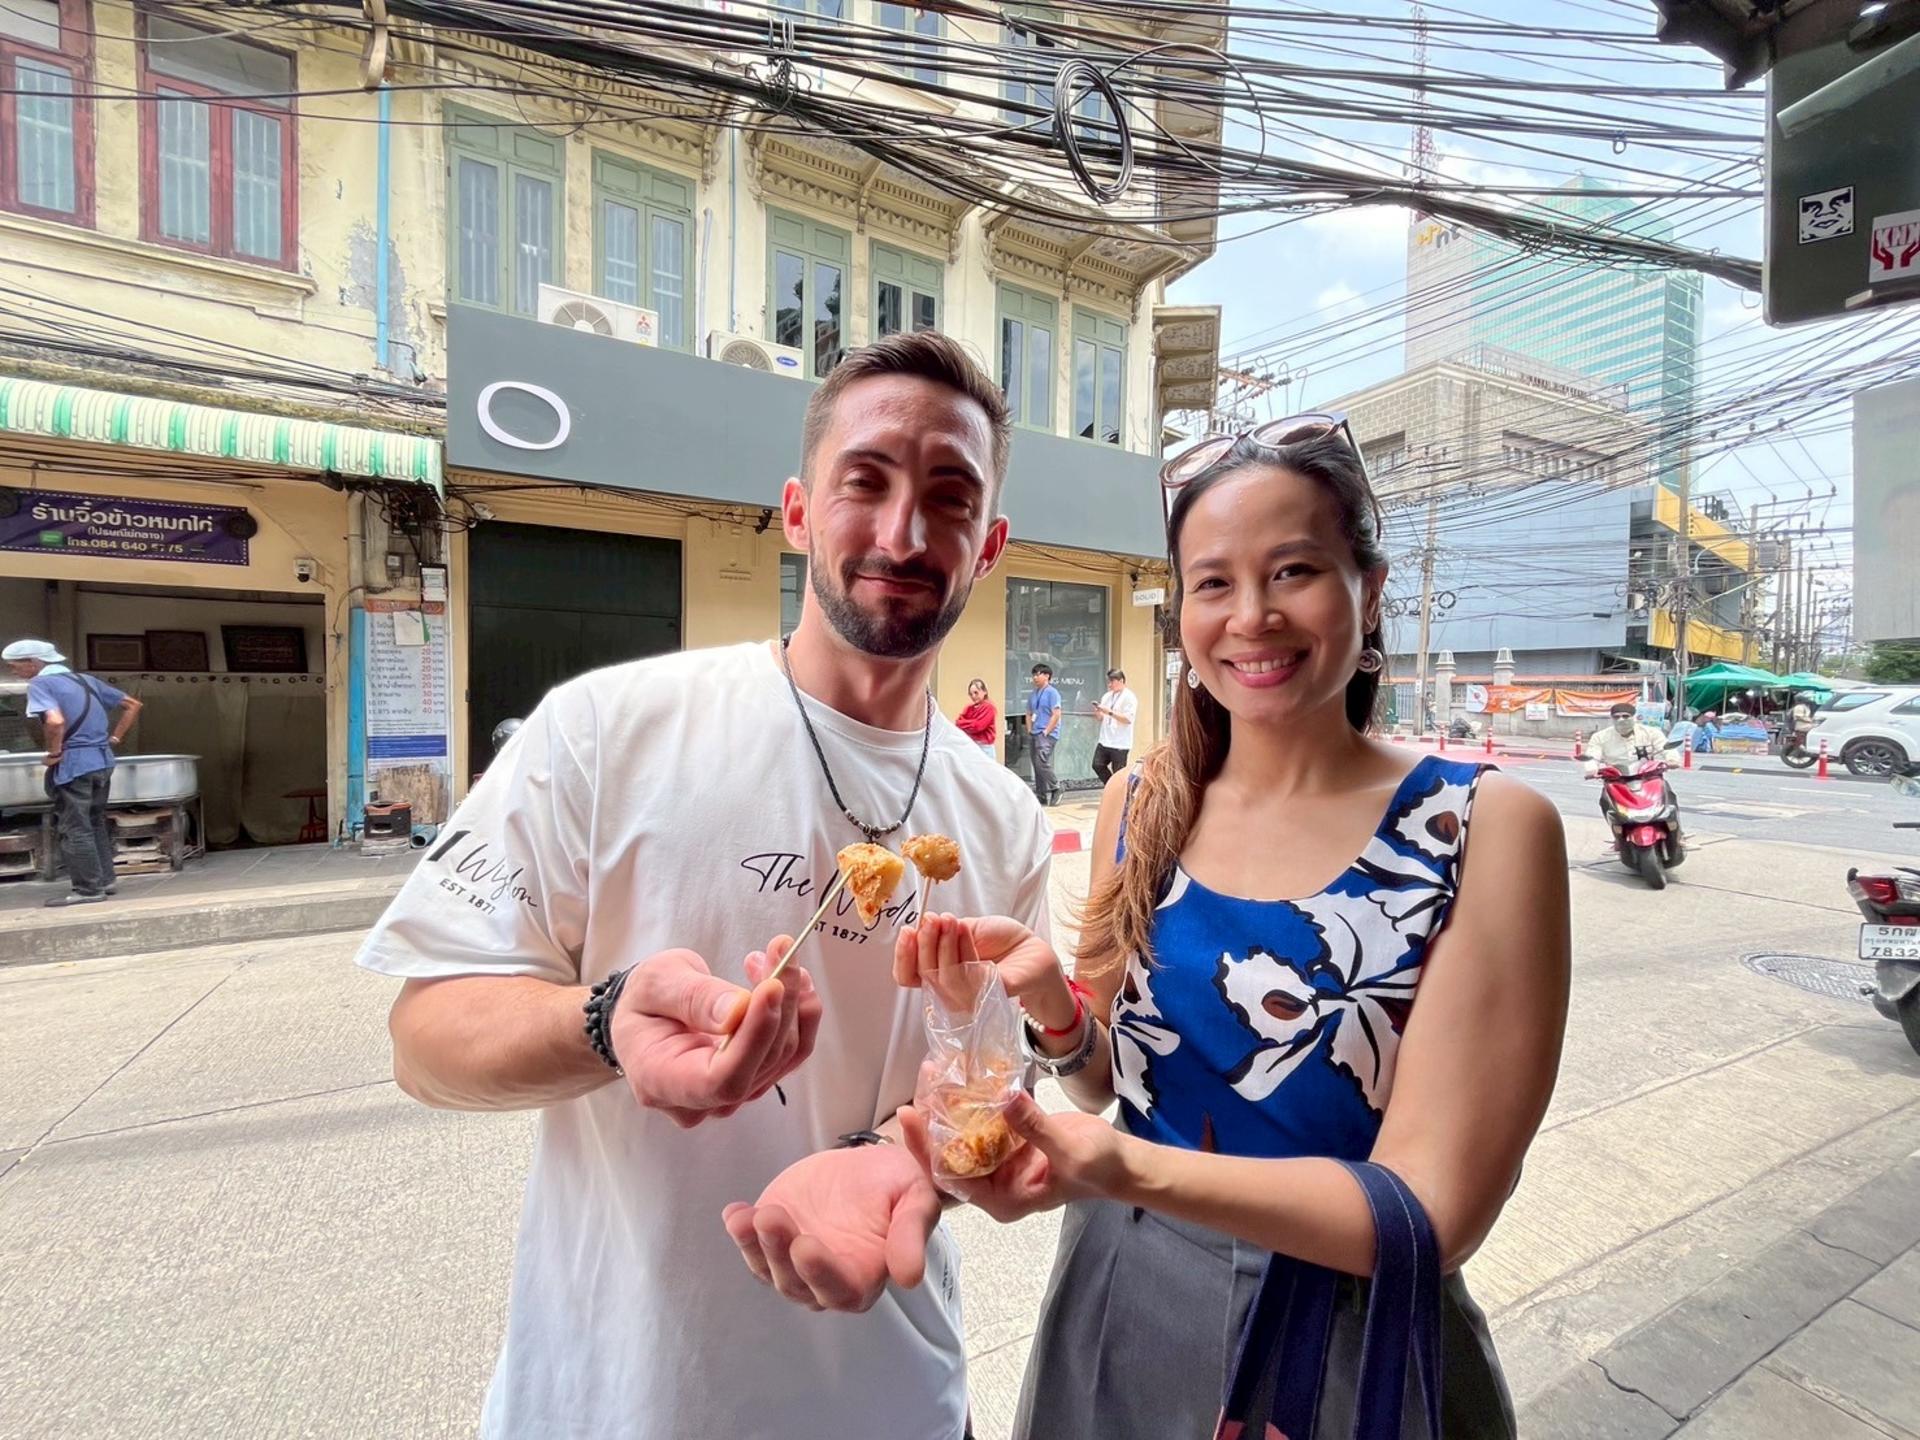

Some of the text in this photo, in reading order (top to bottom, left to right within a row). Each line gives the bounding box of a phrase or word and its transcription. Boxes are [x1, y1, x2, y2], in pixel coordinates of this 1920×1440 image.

[121, 541, 147, 552] 640
[1061, 677, 1085, 685] MENU
[740, 853, 814, 897] The
[440, 878, 496, 915] EST 1877
[832, 925, 868, 944] 1877
[1871, 946, 1919, 957] 7832
